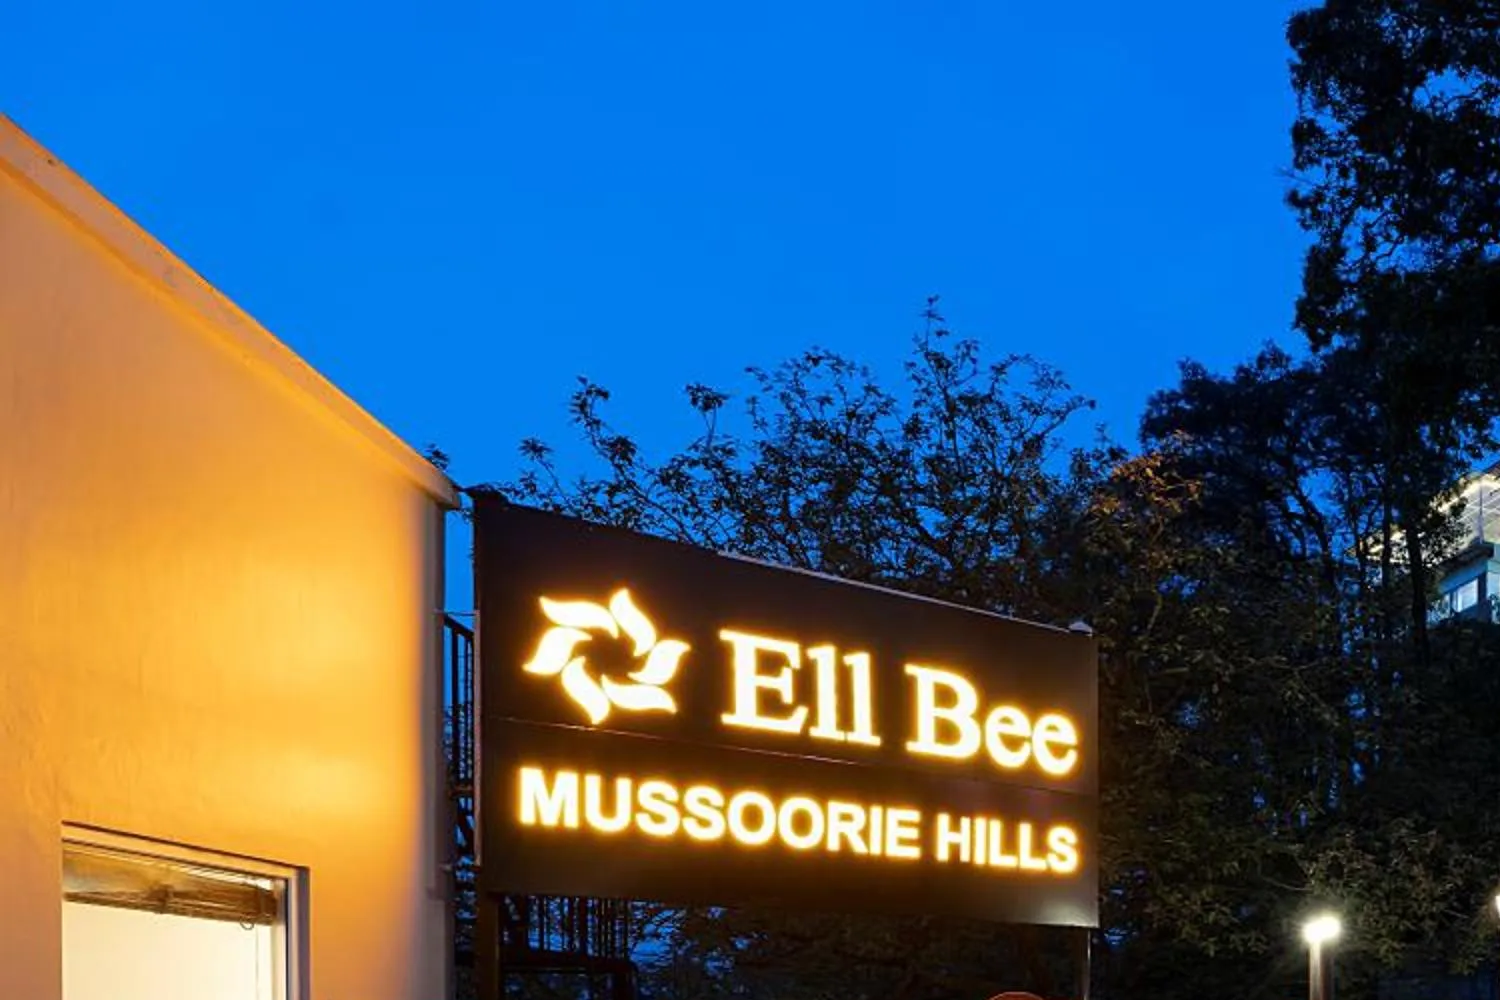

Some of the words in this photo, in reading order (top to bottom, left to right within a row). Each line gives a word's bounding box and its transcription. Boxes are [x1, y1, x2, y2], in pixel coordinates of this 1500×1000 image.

[719, 629, 881, 746] Ell
[904, 663, 1078, 776] Bee
[518, 766, 921, 859] MUSSOORIE
[936, 813, 1079, 874] HILLS
